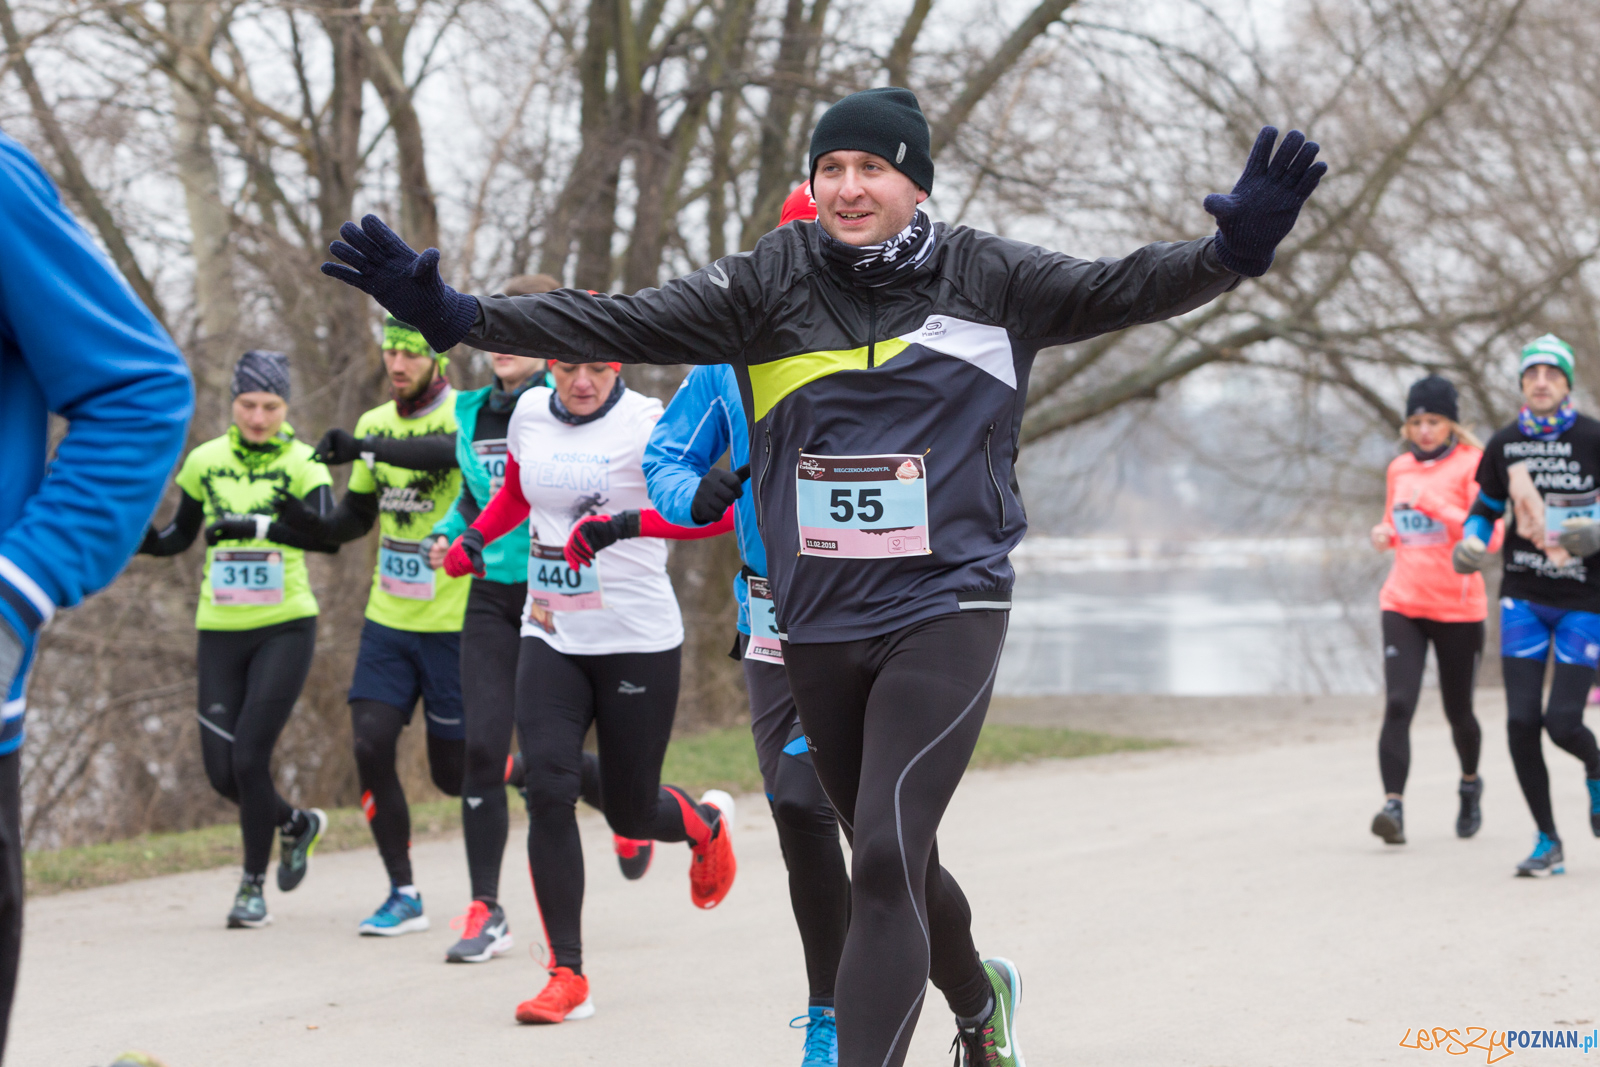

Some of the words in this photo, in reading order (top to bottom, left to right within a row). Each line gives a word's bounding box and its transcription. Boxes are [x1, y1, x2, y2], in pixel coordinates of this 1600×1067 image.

[552, 452, 610, 464] KOŚCIAN
[521, 460, 609, 492] TEAM
[829, 488, 884, 522] 55
[806, 539, 837, 550] 11.02.2018
[223, 565, 269, 585] 315
[385, 556, 420, 577] 439
[538, 564, 582, 589] 440
